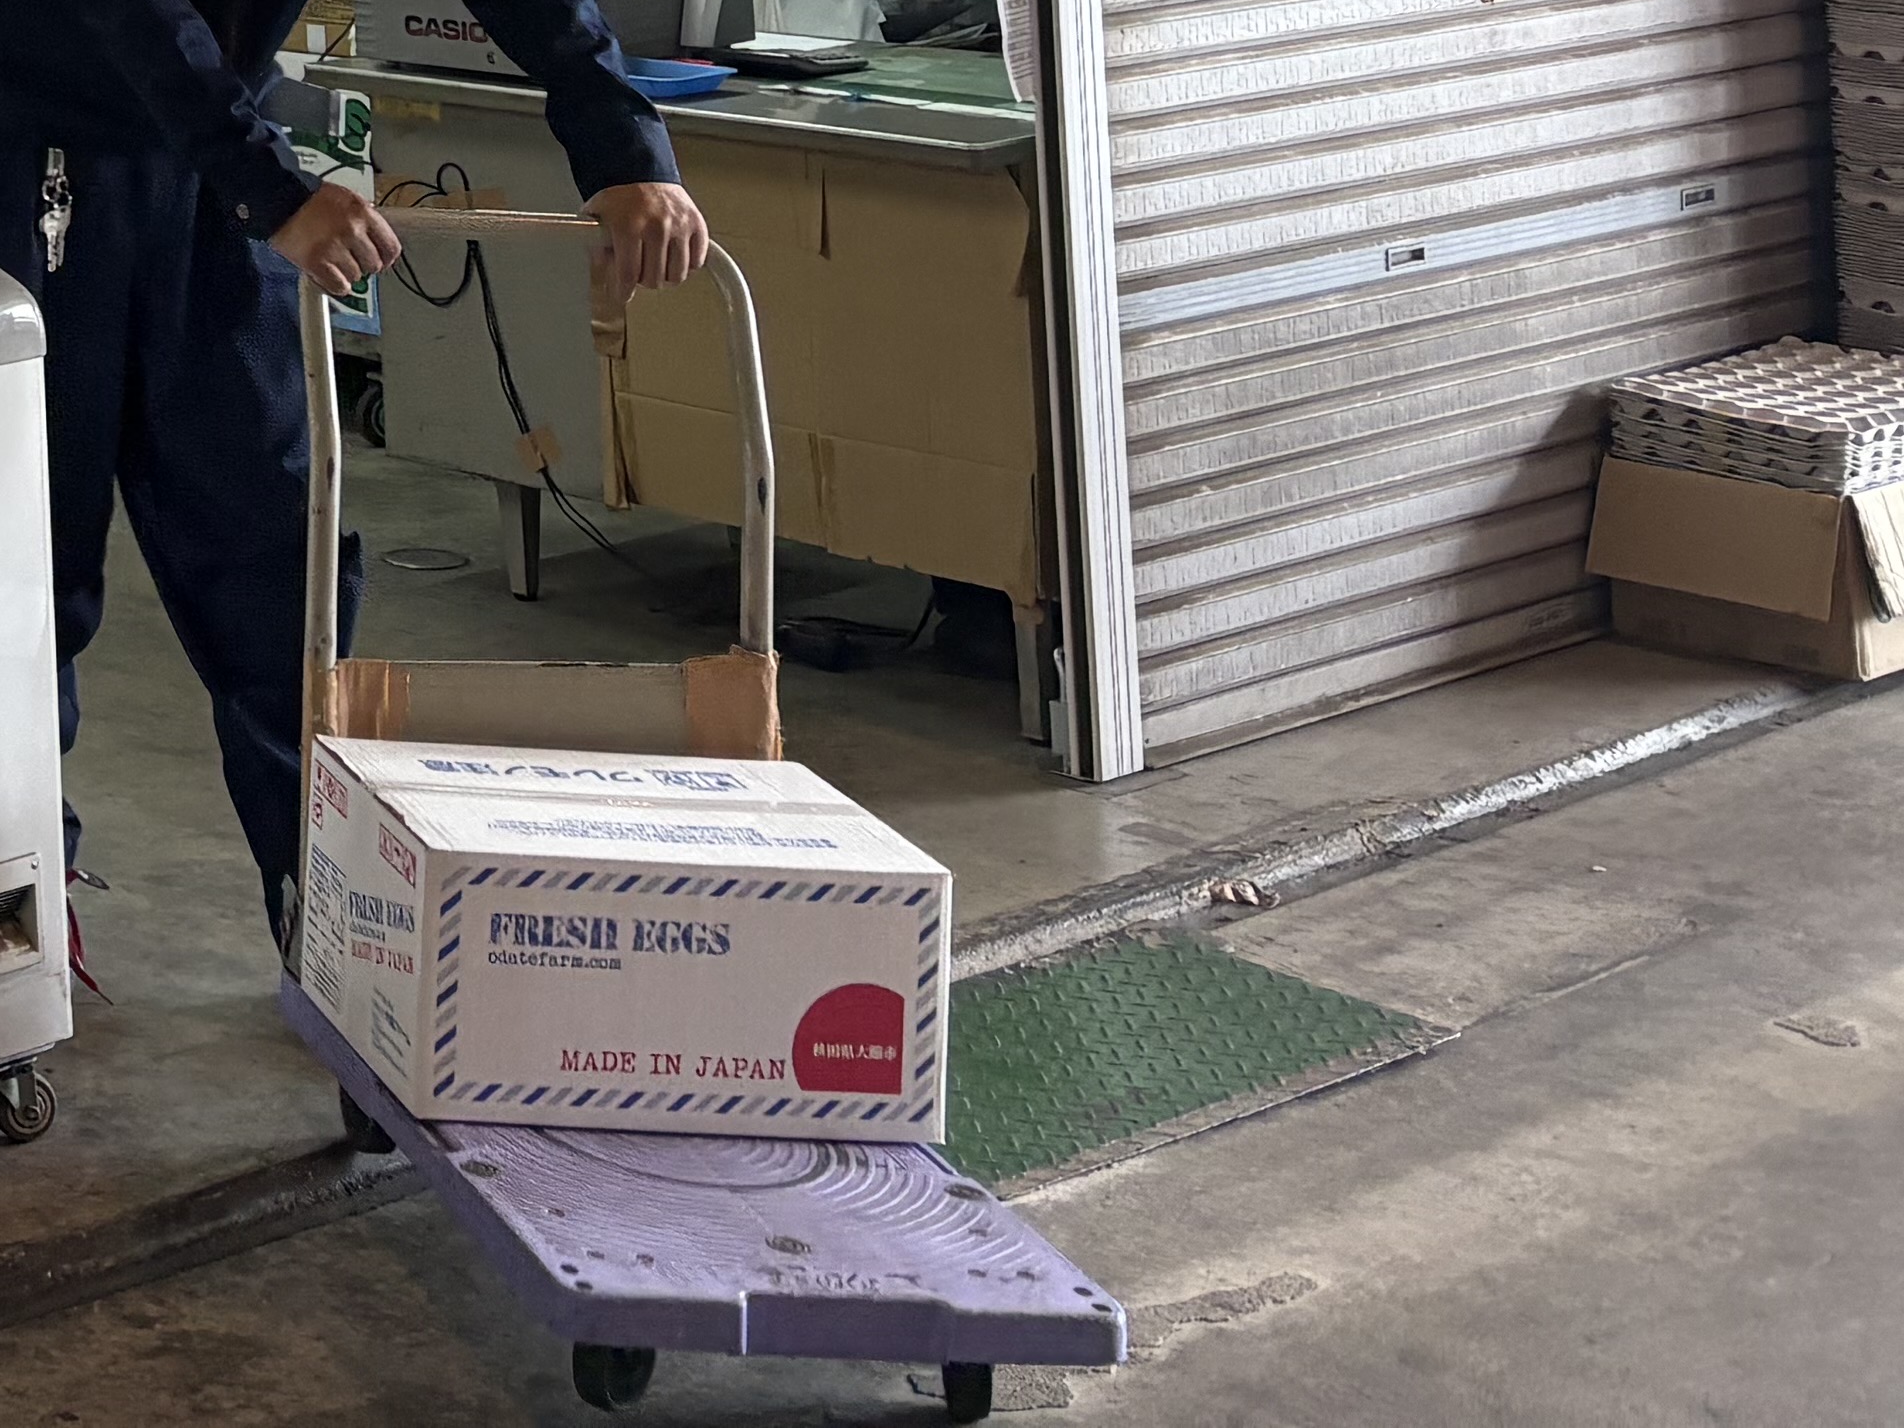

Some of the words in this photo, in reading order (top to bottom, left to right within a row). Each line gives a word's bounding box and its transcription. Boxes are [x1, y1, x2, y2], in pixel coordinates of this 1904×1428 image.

[404, 15, 489, 44] CASIO
[489, 911, 618, 951] FRESH
[631, 918, 731, 956] EGGS
[558, 1047, 636, 1074] MADE
[651, 1052, 682, 1077] IN
[695, 1055, 787, 1082] JAPAN
